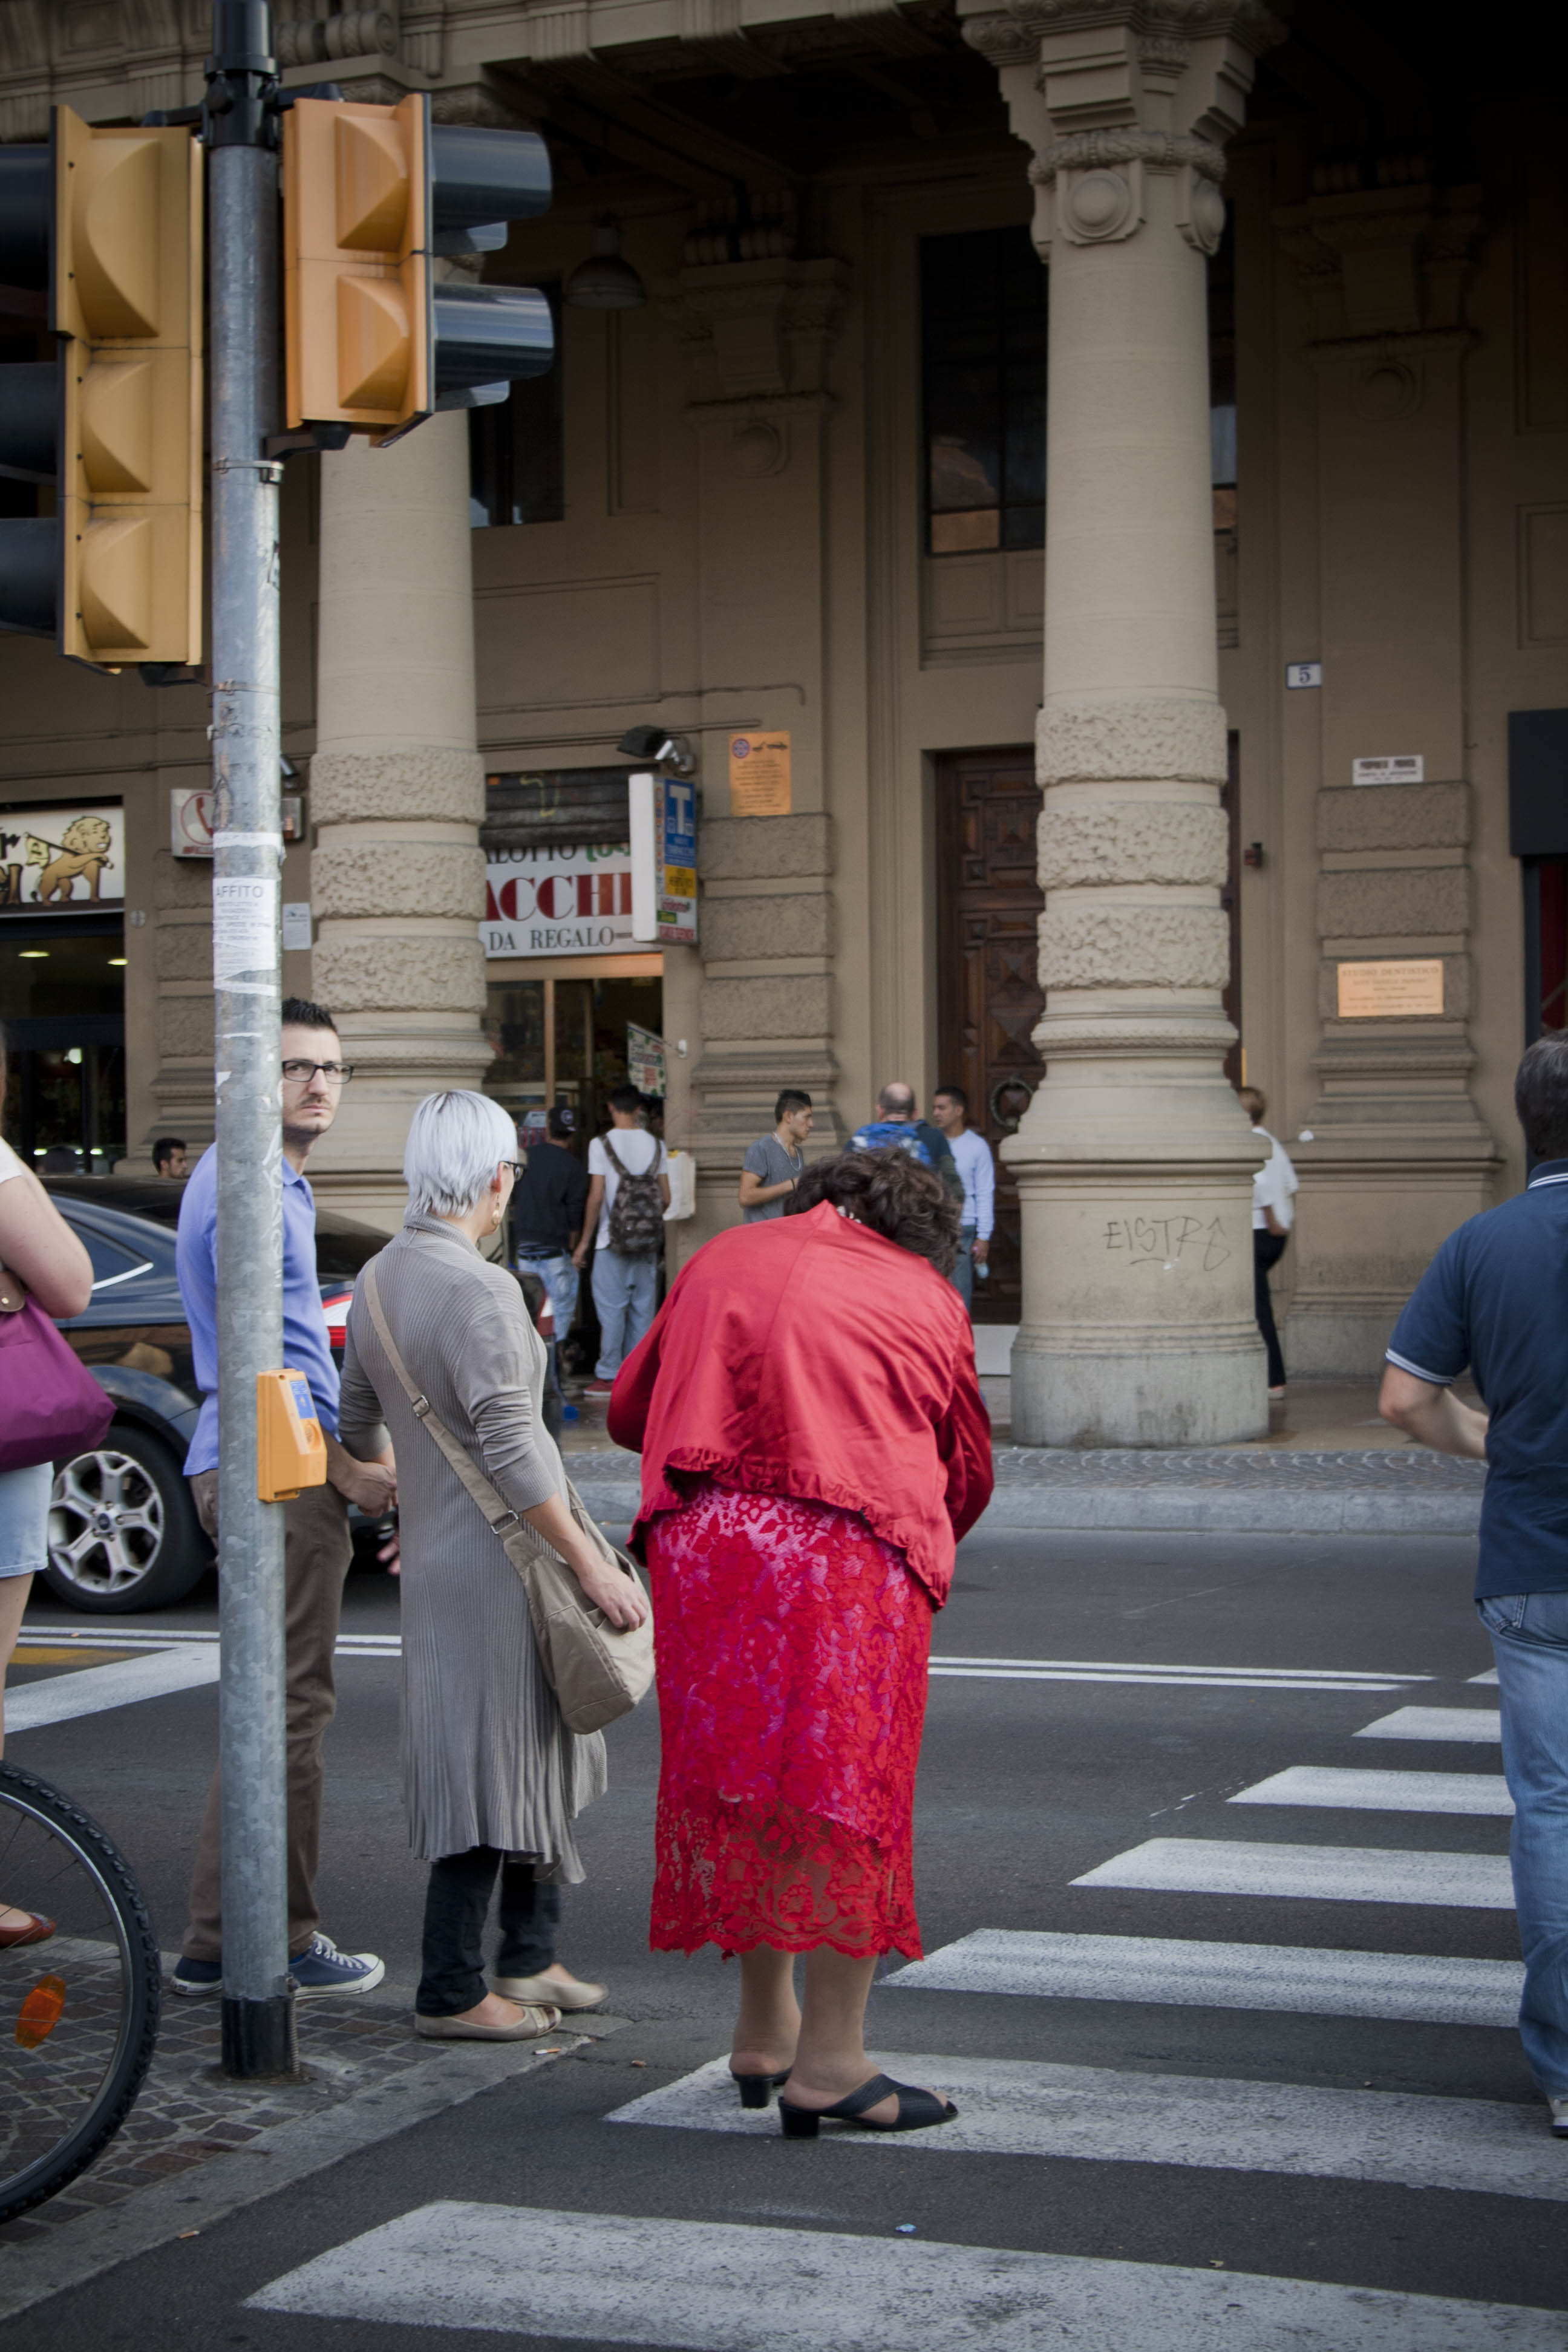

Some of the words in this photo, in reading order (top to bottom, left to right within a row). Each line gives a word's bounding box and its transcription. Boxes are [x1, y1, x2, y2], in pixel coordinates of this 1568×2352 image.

[1299, 666, 1310, 683] 5
[668, 785, 691, 834] T
[217, 886, 263, 898] AFFITO
[489, 932, 516, 951] DA
[530, 926, 615, 949] REGALO
